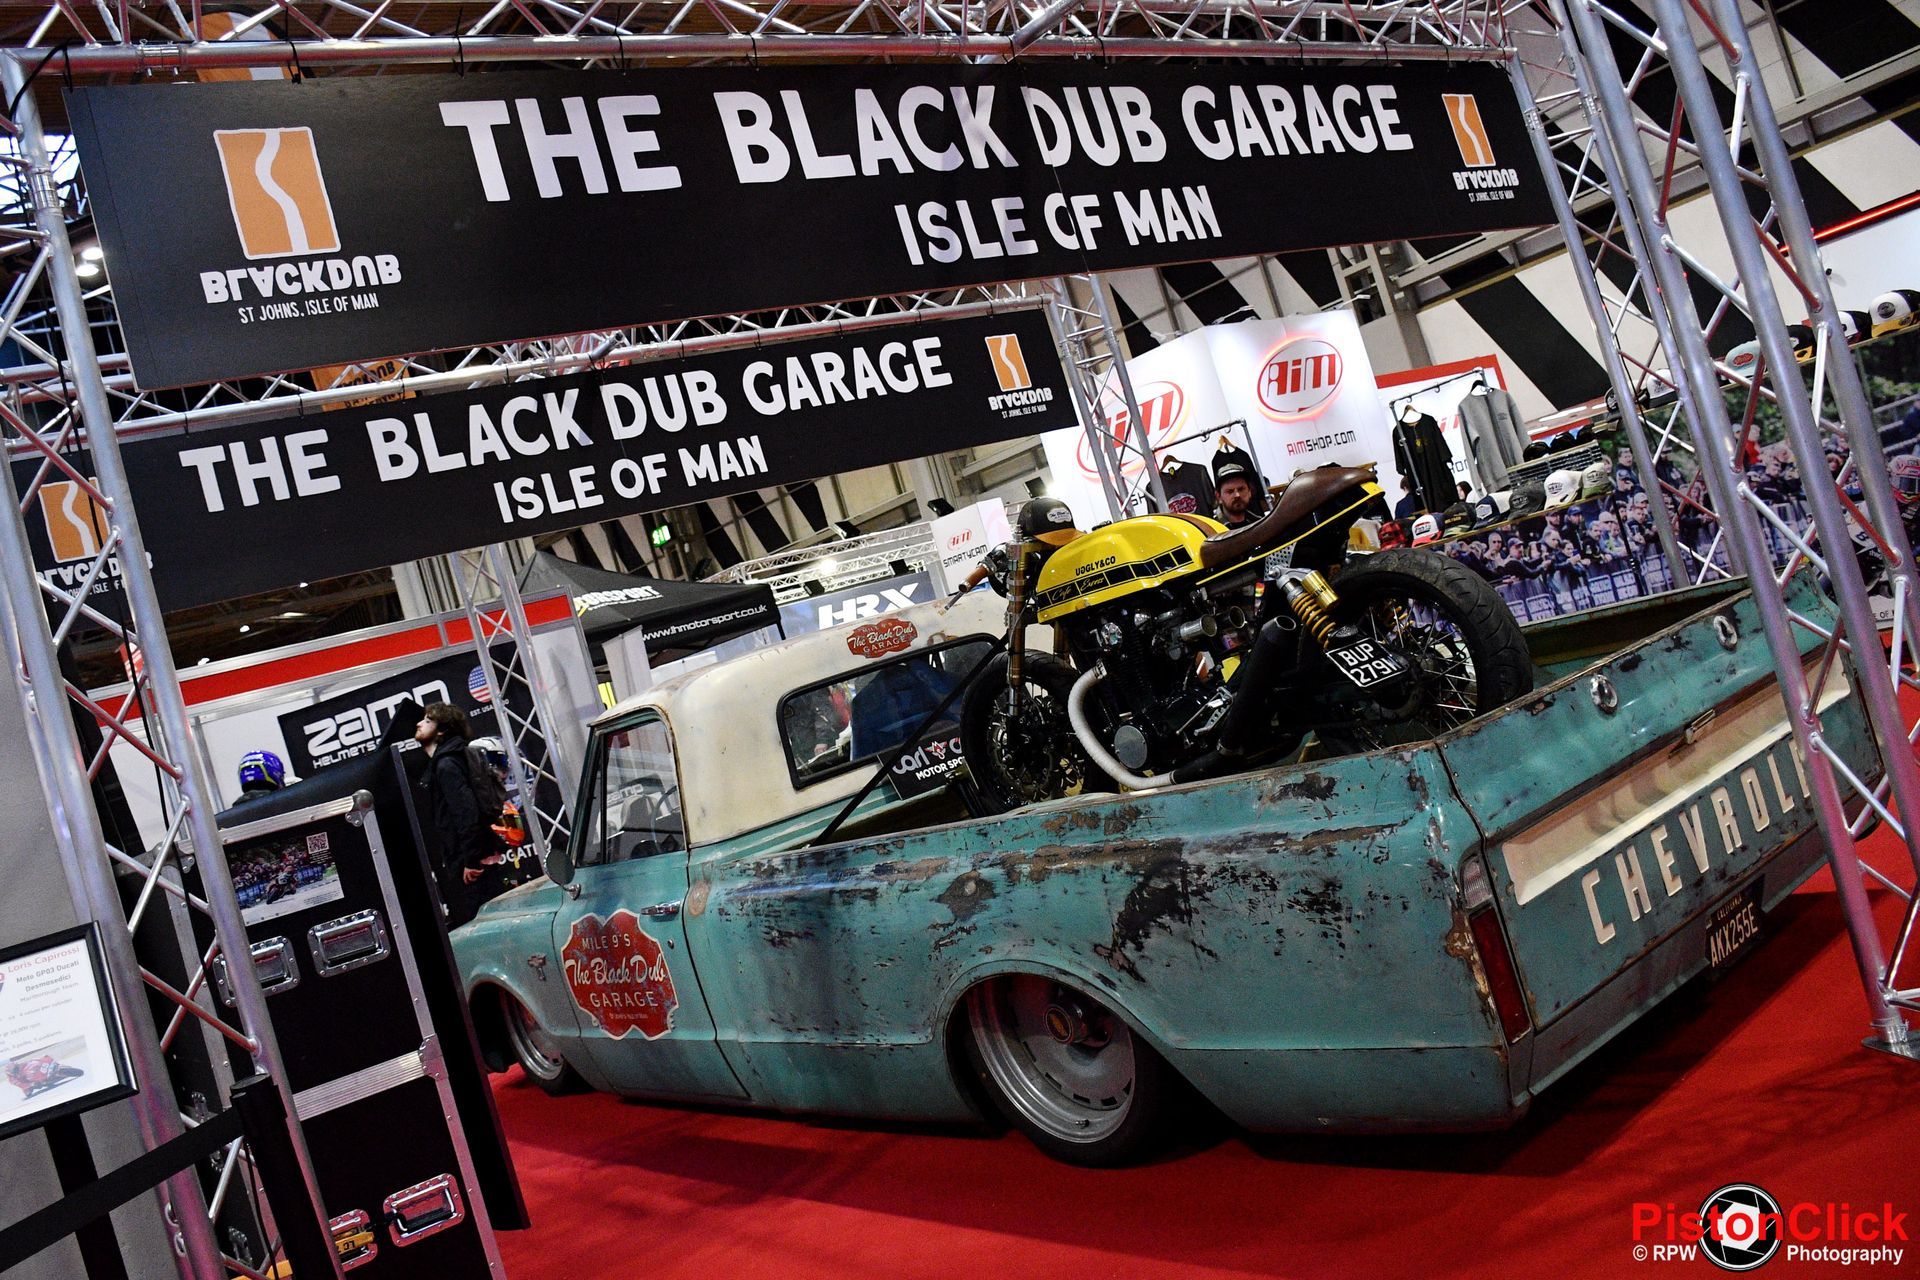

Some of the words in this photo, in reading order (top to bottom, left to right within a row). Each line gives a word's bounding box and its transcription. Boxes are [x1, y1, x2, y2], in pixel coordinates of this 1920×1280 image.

[439, 94, 682, 201] THE
[714, 85, 1019, 184] BLACK
[1020, 84, 1168, 167] DUB
[1181, 84, 1413, 161] GARAGE
[895, 197, 1039, 266] ISLE
[1044, 193, 1101, 249] OF
[1120, 185, 1223, 246] MAN
[238, 307, 254, 324] ST
[306, 298, 331, 316] ISLE
[334, 296, 348, 312] OF
[351, 293, 379, 310] MAN
[180, 429, 341, 512] THE
[366, 389, 591, 482] BLACK
[600, 370, 728, 441] DUB
[742, 337, 952, 415] GARAGE
[1286, 430, 1356, 456] AIMSHOP.COM
[494, 465, 604, 524] ISLE
[611, 452, 669, 498] OF
[681, 436, 768, 484] MAN
[943, 544, 988, 568] SMARTYCAM
[93, 582, 109, 593] ISLE
[818, 582, 919, 630] HRX
[642, 604, 768, 642] www.lhmotorsport.co.uk
[848, 636, 866, 648] The
[867, 628, 893, 644] Black
[893, 622, 913, 638] Dub
[863, 637, 907, 653] GARAGE
[1338, 643, 1374, 666] BUP
[482, 704, 494, 714] USA
[916, 760, 949, 780] MOTOR
[948, 756, 966, 770] SPO
[1582, 719, 1824, 944] CHEVROL
[582, 936, 608, 950] MILE
[1710, 902, 1758, 968] AKX255E
[8, 958, 32, 974] Loris
[34, 946, 80, 966] Capirossi
[16, 972, 34, 984] Moto
[56, 960, 80, 972] Ducati
[564, 957, 591, 986] The
[590, 955, 630, 985] Black
[630, 953, 666, 983] Dub
[26, 974, 72, 992] Desmosedici
[590, 991, 659, 1008] GARAGE
